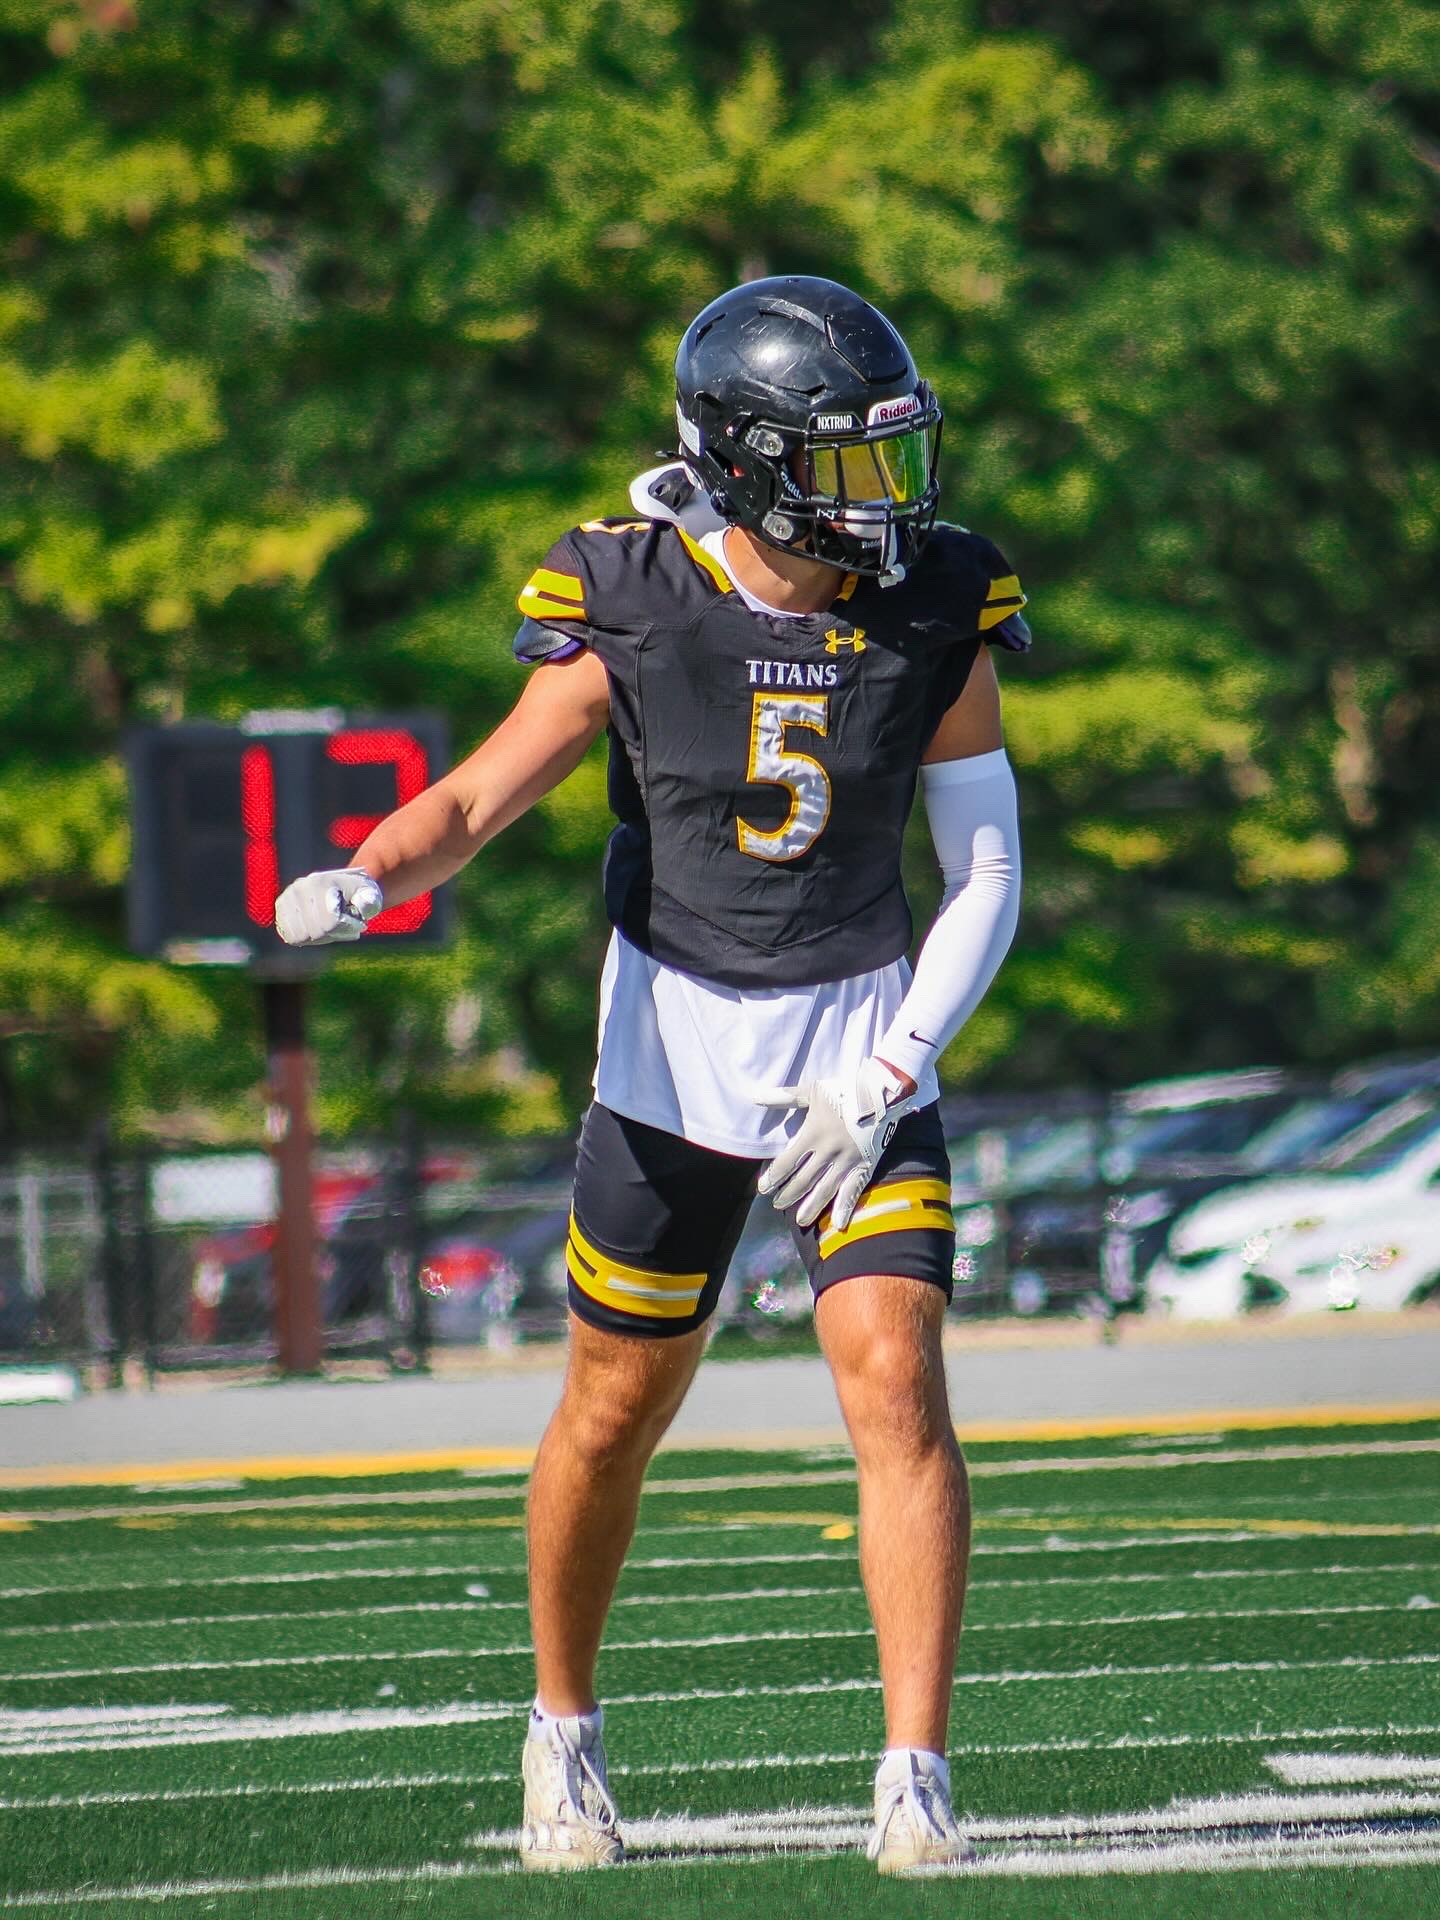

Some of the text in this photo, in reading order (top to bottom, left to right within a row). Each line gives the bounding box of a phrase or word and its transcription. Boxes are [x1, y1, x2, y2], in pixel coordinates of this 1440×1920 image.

[817, 414, 852, 430] NXTRND
[879, 400, 918, 421] Riddell
[745, 659, 838, 687] TITANS
[736, 692, 832, 861] 5
[240, 728, 433, 934] 13
